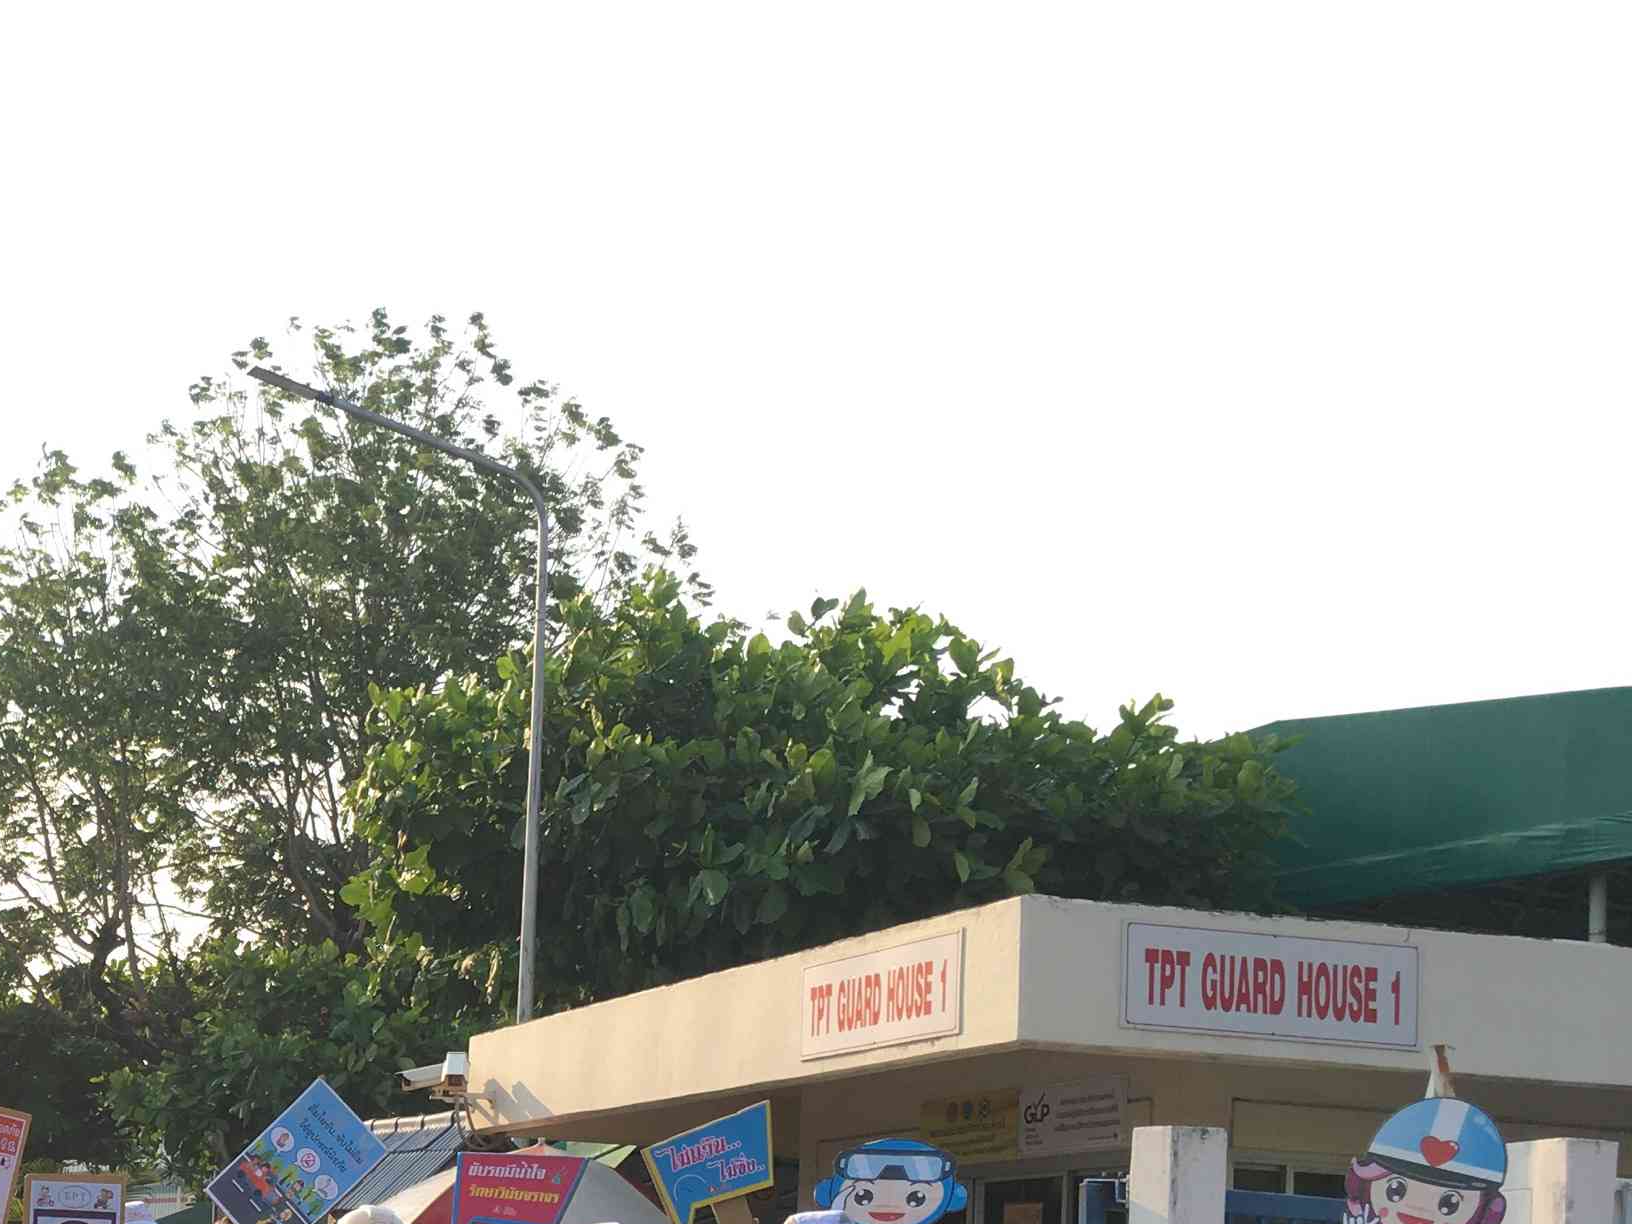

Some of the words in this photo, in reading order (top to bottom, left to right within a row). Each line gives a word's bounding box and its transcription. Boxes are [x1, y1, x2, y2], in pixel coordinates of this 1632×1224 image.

[811, 984, 833, 1037] TPT
[837, 974, 882, 1032] GUARD
[886, 960, 934, 1023] HOUSE
[940, 959, 948, 1012] 1
[1145, 948, 1191, 1007] TPT
[1201, 952, 1286, 1015] GUARD
[1296, 960, 1378, 1024] HOUSE
[1391, 971, 1401, 1025] 1
